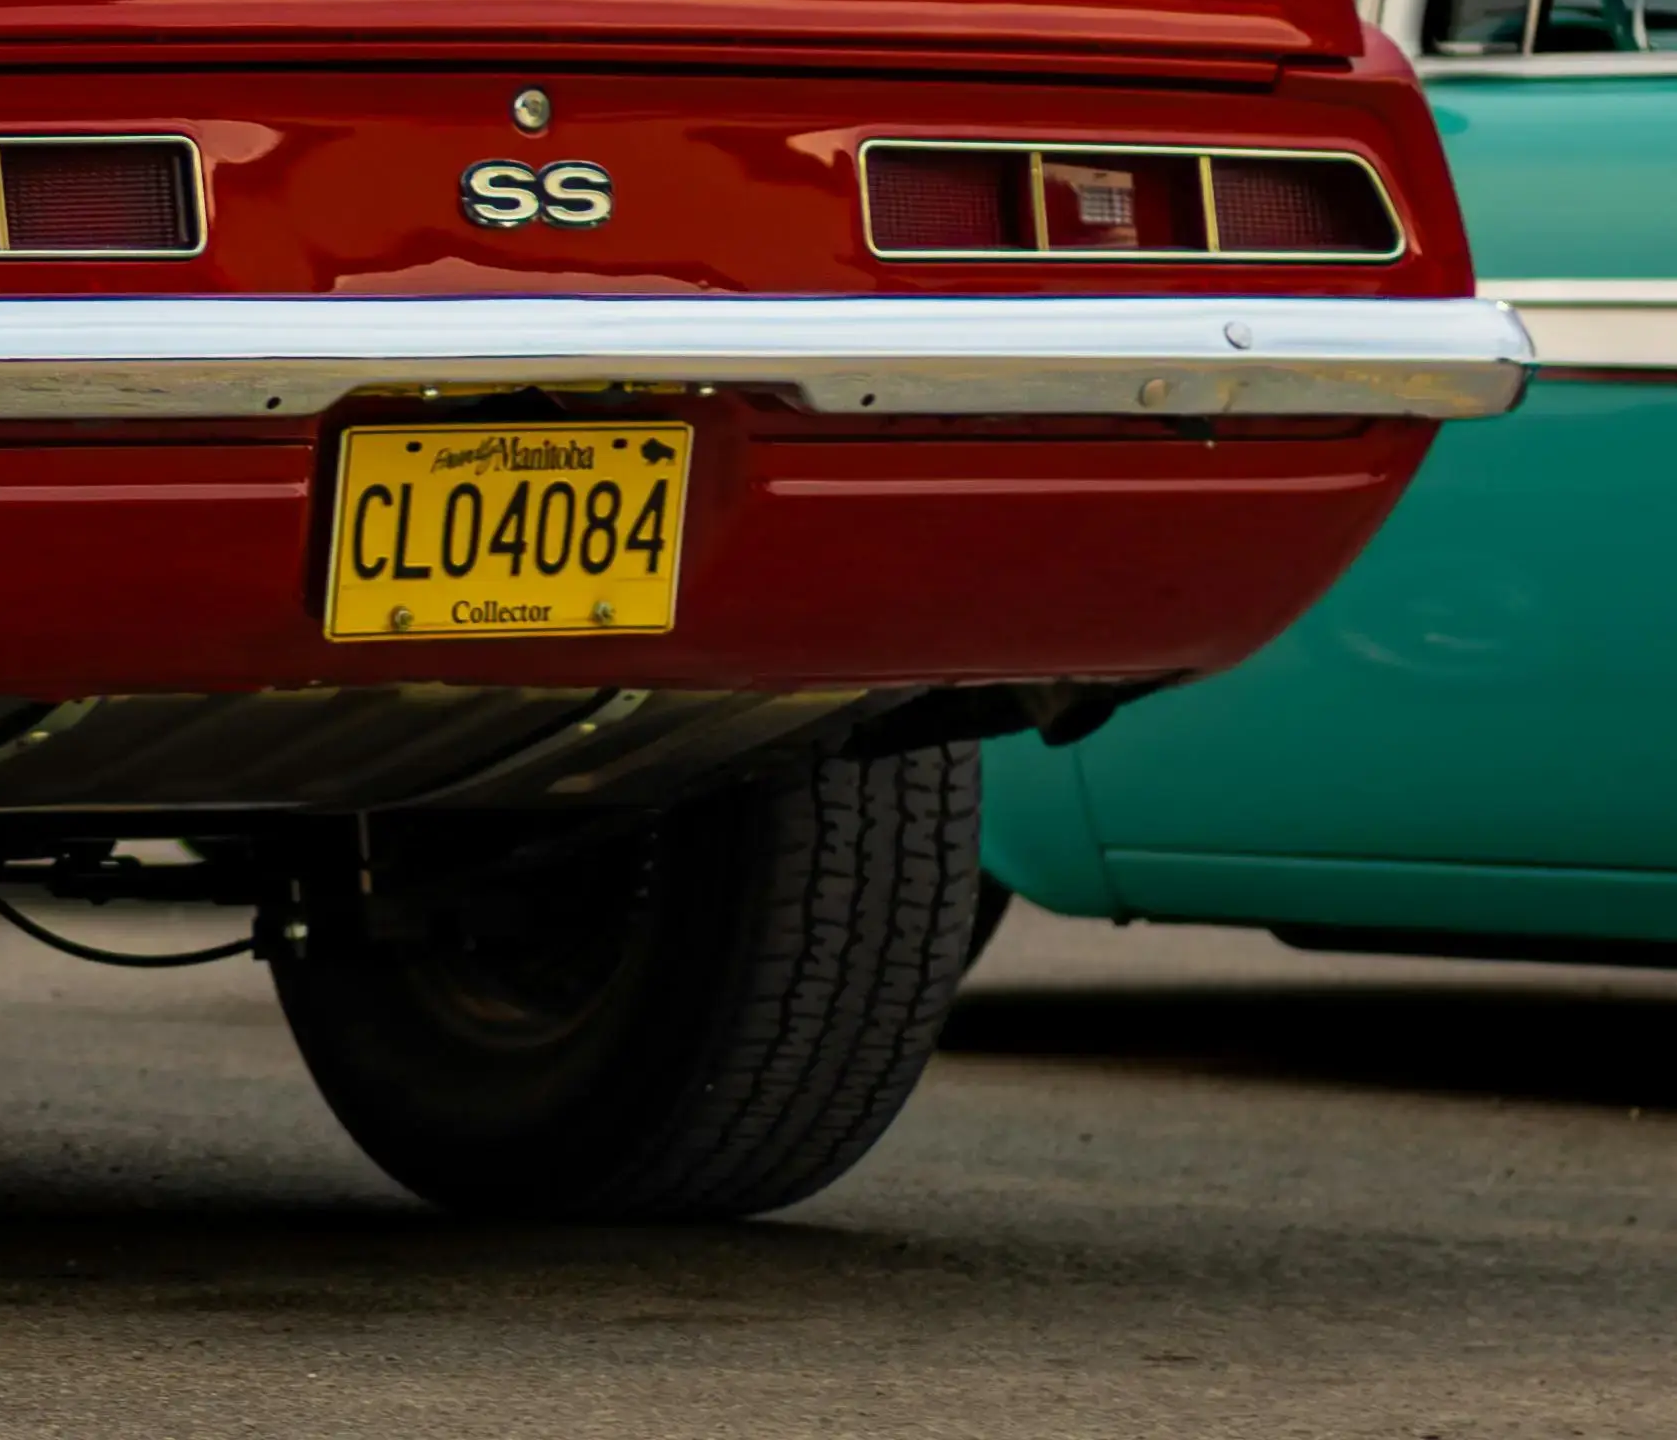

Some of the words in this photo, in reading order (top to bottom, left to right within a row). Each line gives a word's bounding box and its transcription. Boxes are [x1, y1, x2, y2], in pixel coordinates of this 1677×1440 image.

[466, 161, 613, 225] SS
[494, 436, 595, 472] Manitoba
[352, 478, 668, 580] CL04084
[451, 600, 552, 625] Collector
